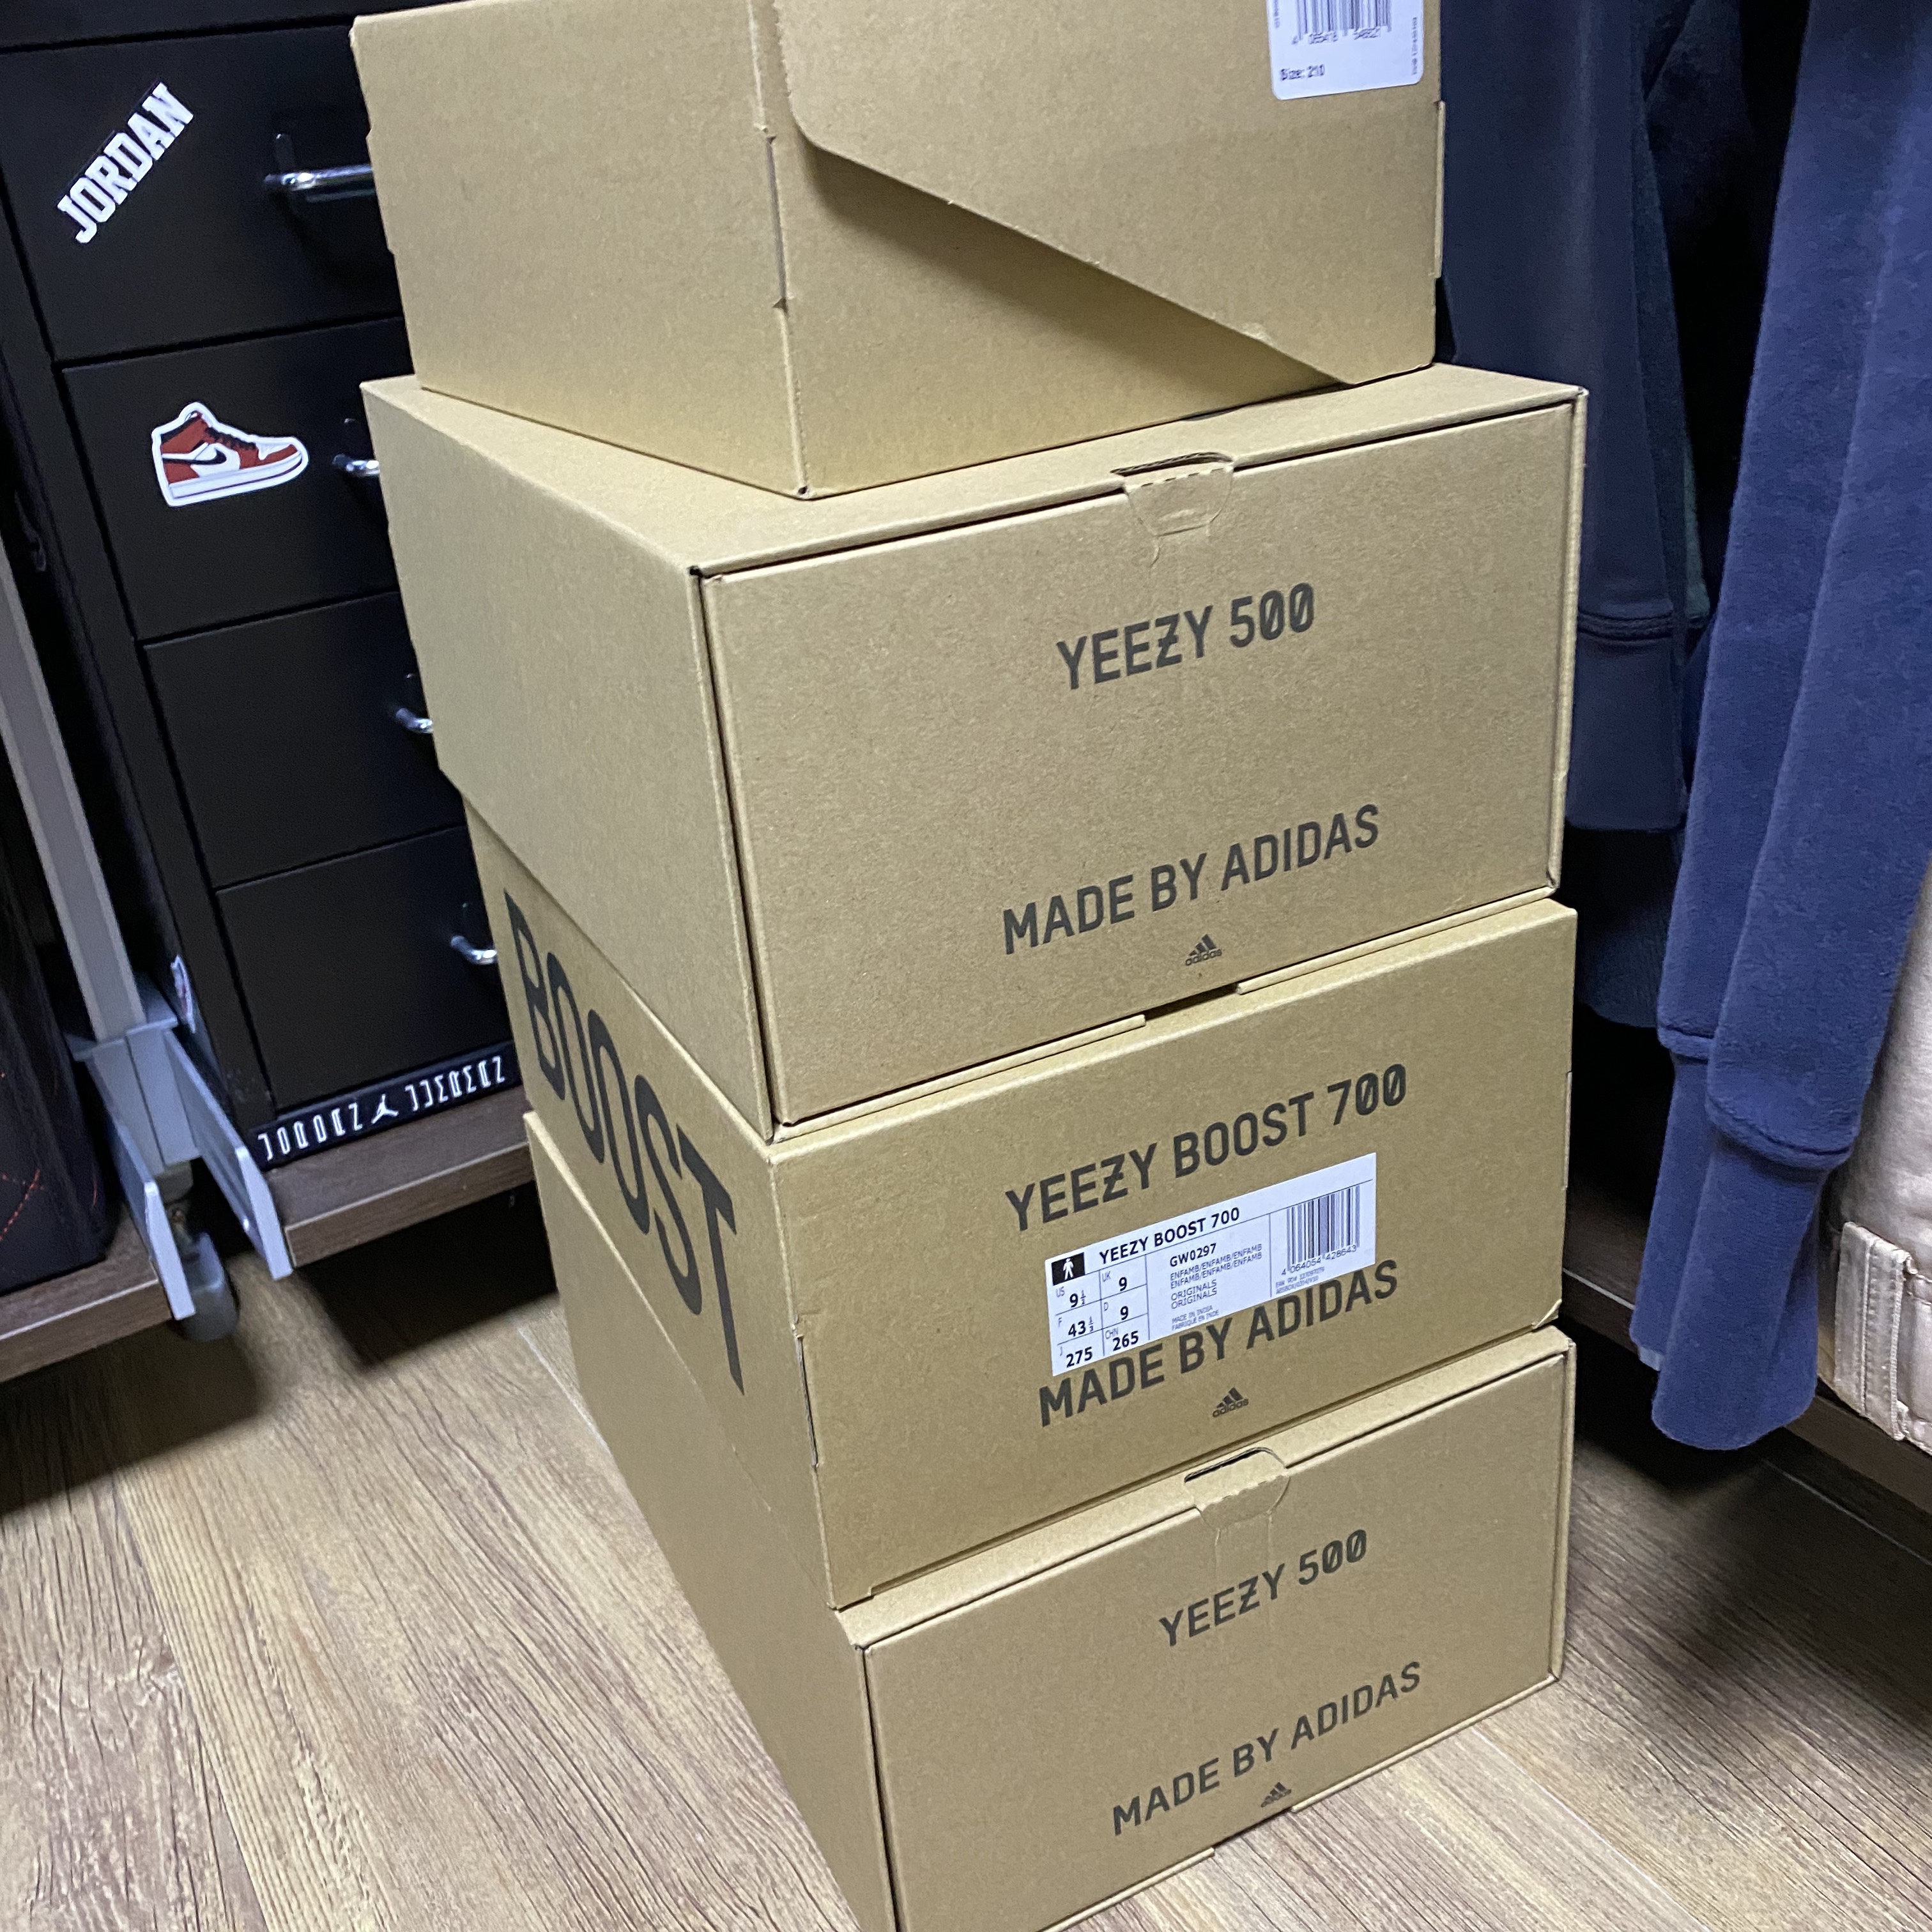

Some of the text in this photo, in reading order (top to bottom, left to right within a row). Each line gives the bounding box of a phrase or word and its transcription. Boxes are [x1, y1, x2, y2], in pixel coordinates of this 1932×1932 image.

[57, 82, 194, 245] JORDAN
[1055, 583, 1315, 690] YEEZY 500
[1002, 804, 1379, 955] MADE BY ADIDAS
[1184, 948, 1222, 966] adidas
[504, 887, 745, 1395] BOOST
[1006, 1064, 1406, 1232] YEEZY BOOST 700
[1099, 1207, 1240, 1264] YEEZY BOOST 700
[1170, 1243, 1216, 1267] GW0297
[1170, 1243, 1262, 1281] ENFAMB/ENFAMB/ENFAMB
[1290, 1257, 1321, 1274] 064054
[1326, 1245, 1357, 1261] 428643
[1102, 1270, 1111, 1282] UK
[1119, 1276, 1127, 1291] 9
[1170, 1252, 1262, 1289] ENFAMB/ENFAMB/ENFAMB
[1056, 1286, 1065, 1298] US
[1171, 1279, 1217, 1301] ORIGINALS
[1171, 1287, 1218, 1309] ORIGINALS
[1103, 1302, 1109, 1311] D
[1120, 1305, 1129, 1321] 9
[1039, 1259, 1398, 1428] MADE BY ADIDAS
[1112, 1330, 1139, 1352] 265
[1066, 1346, 1093, 1368] 275
[1212, 1398, 1249, 1418] adidas
[1158, 1529, 1367, 1647] YEEZY 500
[1112, 1661, 1420, 1836] MADE BY ADIDAS
